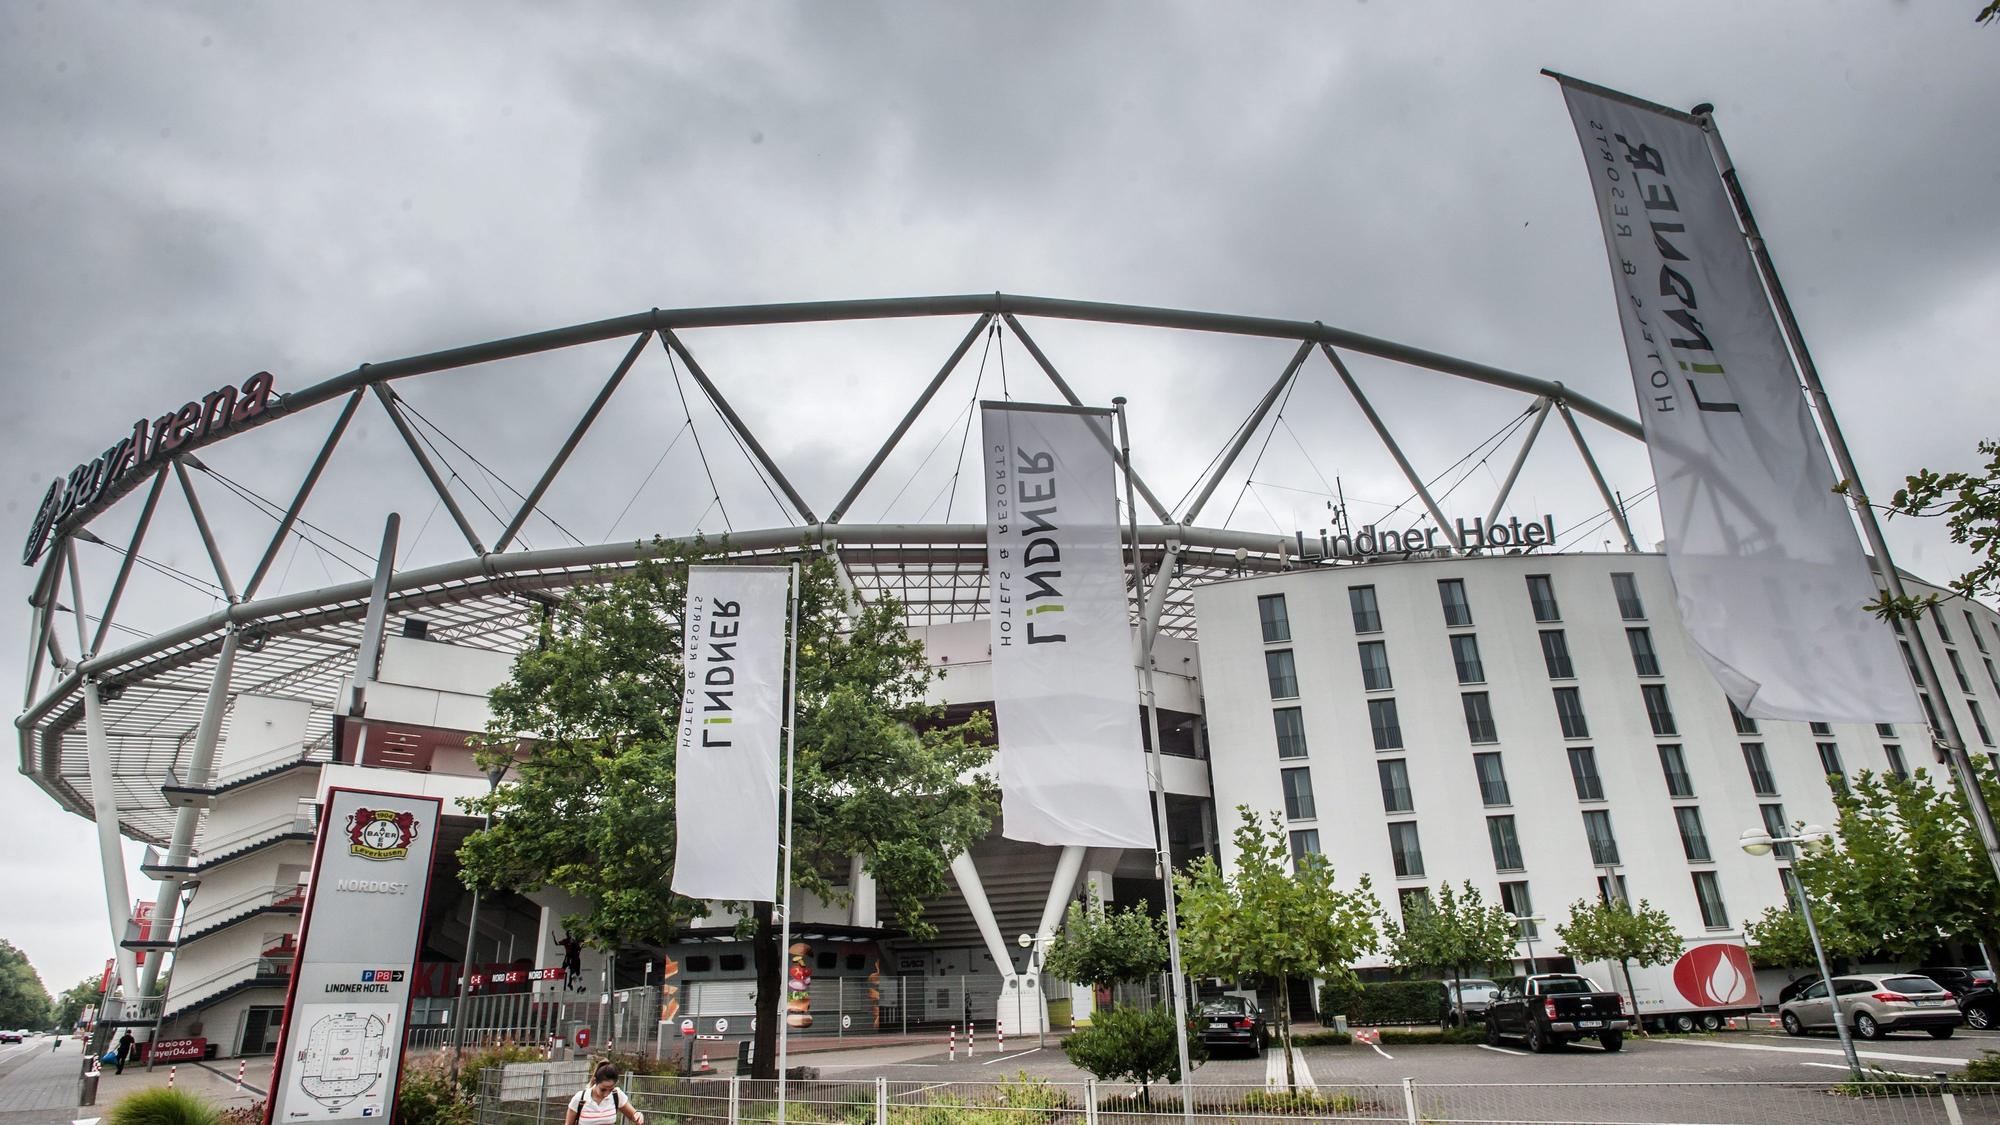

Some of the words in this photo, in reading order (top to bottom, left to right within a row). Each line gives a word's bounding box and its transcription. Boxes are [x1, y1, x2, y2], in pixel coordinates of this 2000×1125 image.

[1295, 524, 1438, 562] Lindner
[1456, 514, 1557, 548] Hotel
[377, 812, 394, 820] 1904
[366, 830, 397, 838] BAYER
[354, 845, 403, 857] Leverkusen
[336, 879, 408, 895] NORDOST
[376, 971, 390, 980] P8
[491, 973, 505, 983] NORD
[528, 970, 542, 980] NORD
[325, 983, 361, 993] LINDNER
[363, 983, 389, 993] HOTEL
